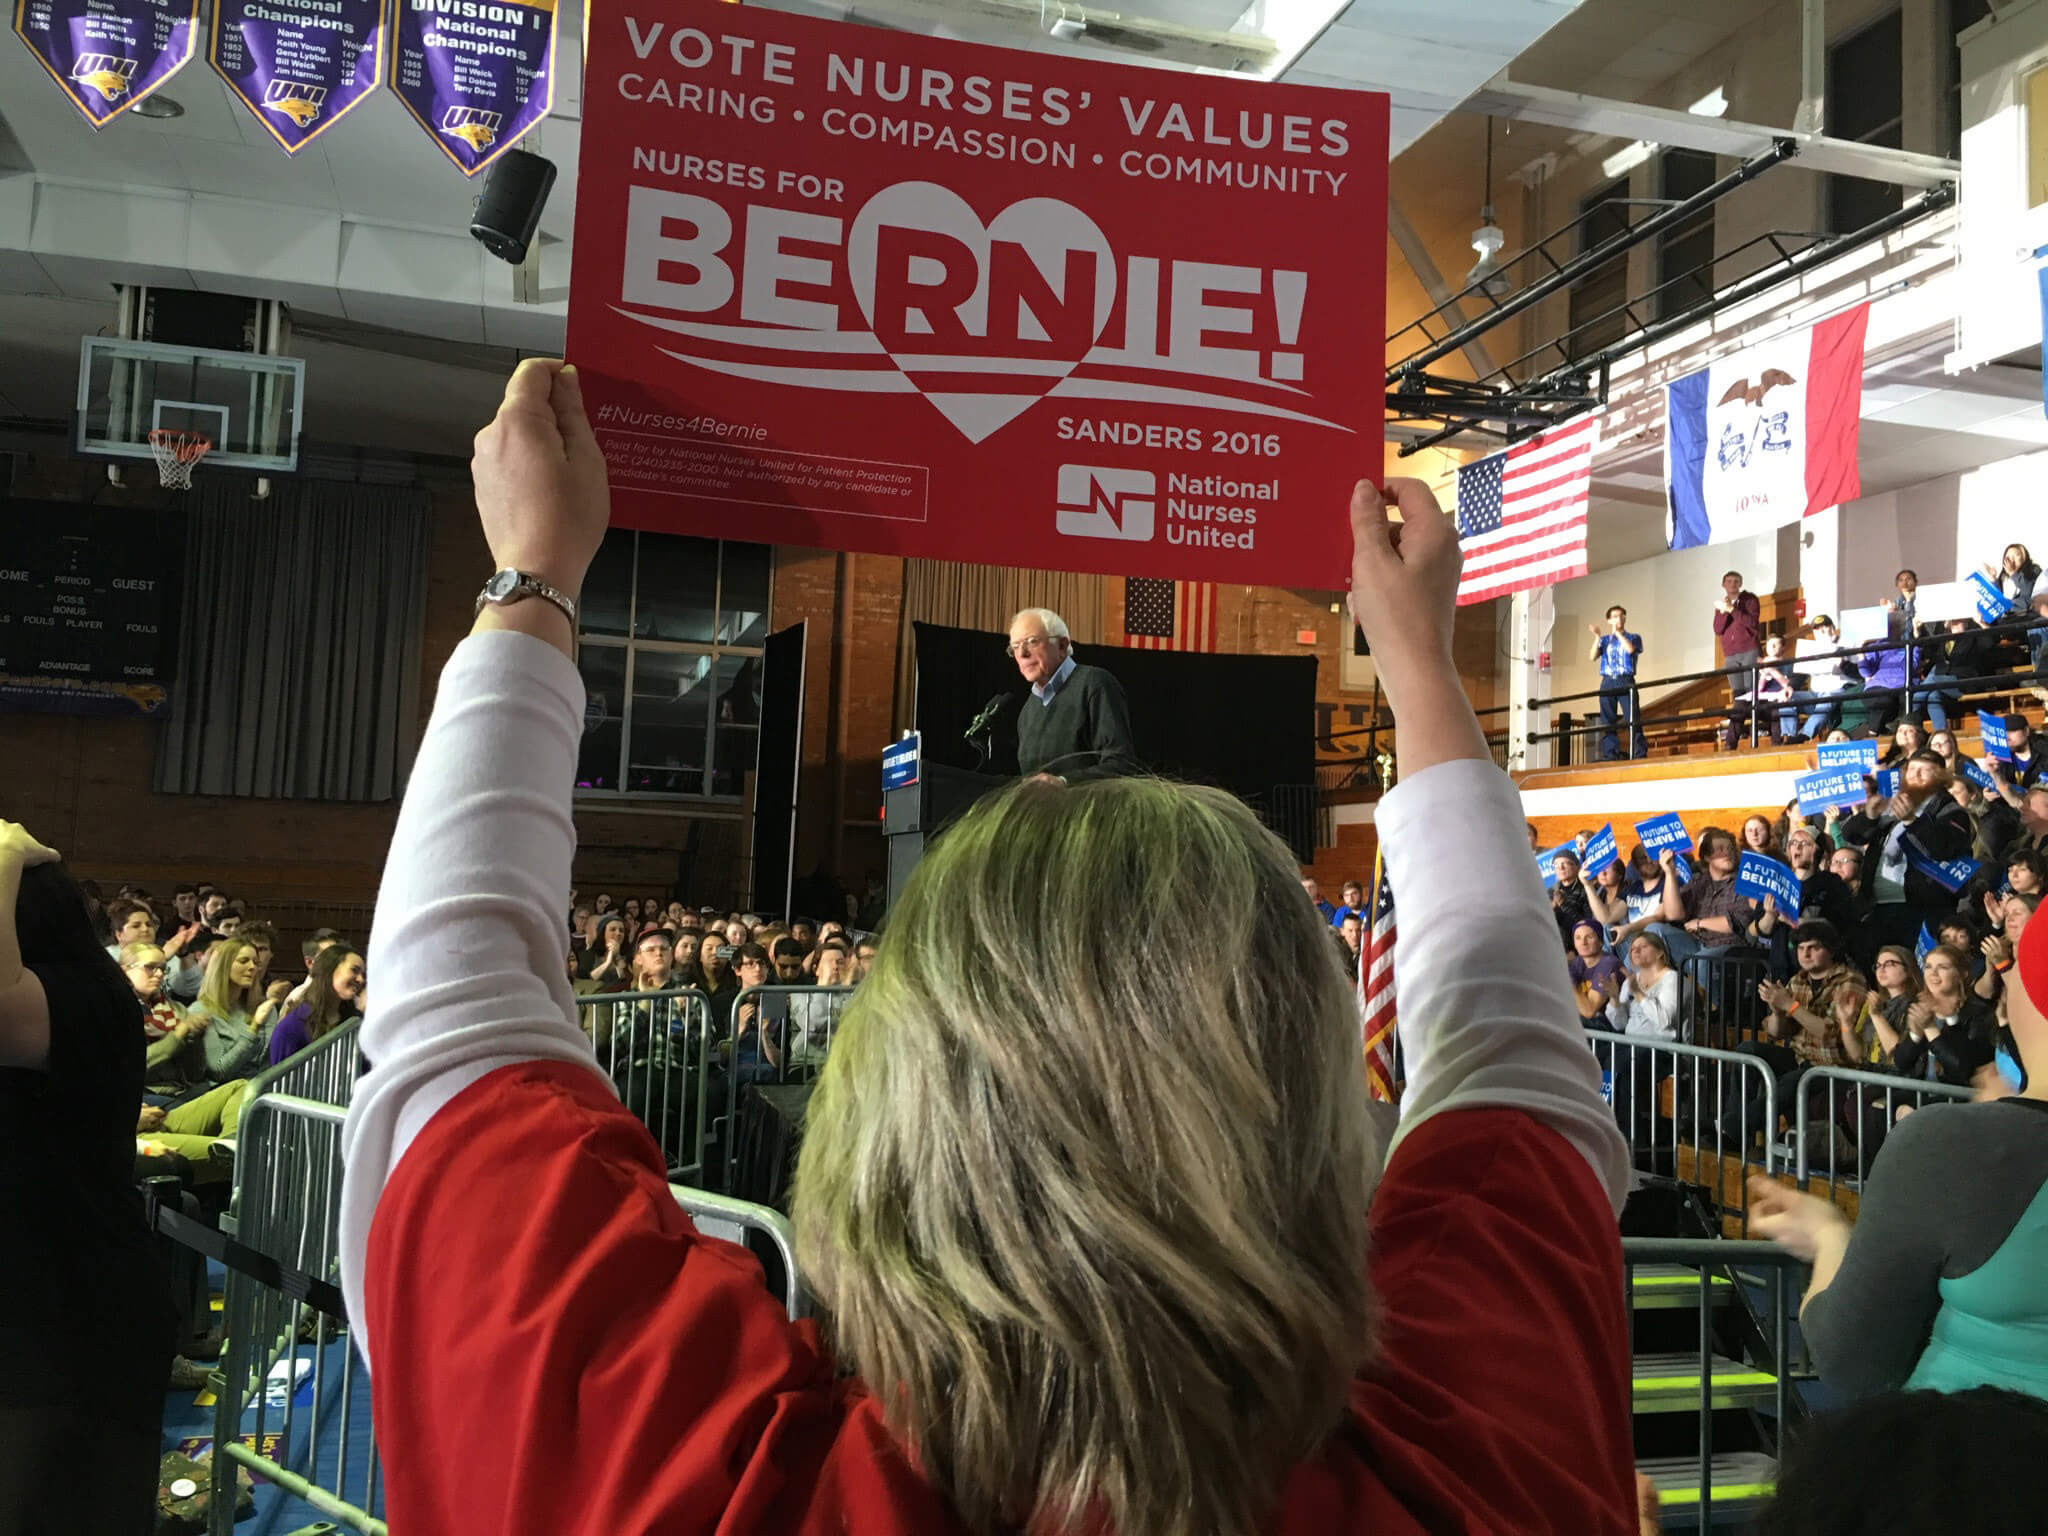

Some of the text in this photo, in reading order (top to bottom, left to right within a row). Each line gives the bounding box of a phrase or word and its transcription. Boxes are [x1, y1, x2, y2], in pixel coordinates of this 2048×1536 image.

[87, 10, 100, 18] Bill
[88, 0, 187, 26] Name Weight
[243, 4, 355, 34] Champions
[411, 0, 524, 26] DIVISION
[86, 20, 100, 28] Bill
[102, 22, 127, 33] Smith
[435, 17, 517, 42] National
[85, 30, 108, 39] Keith
[109, 33, 136, 46] Young
[225, 22, 373, 53] Year Name Weight
[276, 39, 298, 48] Keith
[301, 42, 326, 54] Young
[276, 48, 298, 58] Gene
[300, 51, 331, 64] Lybbert
[423, 33, 528, 61] Champions
[72, 52, 138, 80] UNI
[275, 57, 290, 65] Bill
[404, 48, 546, 79] Year Name Weight
[454, 66, 468, 74] Bill
[274, 67, 290, 75] Jim
[292, 70, 324, 81] Harmon
[454, 74, 468, 83] Bill
[264, 79, 328, 105] UNI
[454, 83, 472, 94] Tony
[474, 87, 497, 97] Davis
[624, 16, 796, 85] VOTE
[1119, 97, 1350, 157] VALUES
[443, 106, 503, 130] UNI
[618, 73, 1347, 196] CARING COMPASSION COMMUNITY
[633, 147, 844, 202] NURSES FOR
[622, 184, 1307, 381] BERNIE!
[597, 405, 768, 441] #Nurses4Bernie
[1056, 416, 1281, 457] SANDERS 2016
[604, 439, 912, 484] Paid for by National Nurses United for Patient Protection
[605, 452, 628, 464] PAC
[723, 466, 744, 478] Not
[747, 470, 806, 486] authorized
[808, 478, 822, 488] by
[824, 481, 843, 491] any
[845, 480, 898, 496] candidate
[900, 488, 912, 497] or
[608, 467, 666, 482] andidate's
[1167, 472, 1279, 500] National
[1166, 498, 1257, 525] Nurses
[1166, 523, 1254, 550] United
[54, 575, 91, 586] PERIOD
[112, 578, 155, 592] GUEST
[53, 605, 86, 616] BONUS
[23, 616, 56, 626] FOULS
[66, 618, 103, 630] PLAYER
[126, 624, 157, 634] FOULS
[38, 660, 91, 672] ADVANTAGE
[124, 666, 154, 676] SCORE
[1828, 749, 1861, 758] FUTURE
[1863, 748, 1875, 756] TO
[1806, 776, 1843, 790] FUTURE
[1846, 772, 1860, 782] TO
[1800, 784, 1846, 803] BELIEVE
[1848, 781, 1862, 792] IN
[1644, 824, 1670, 838] FUTURE
[1669, 821, 1681, 830] TO
[1643, 830, 1687, 848] BELIEVE IN
[1949, 867, 1966, 881] IN
[1956, 860, 1972, 873] TO
[1743, 861, 1800, 900] A FUTURE TO
[1741, 870, 1799, 910] BELIEVE IN
